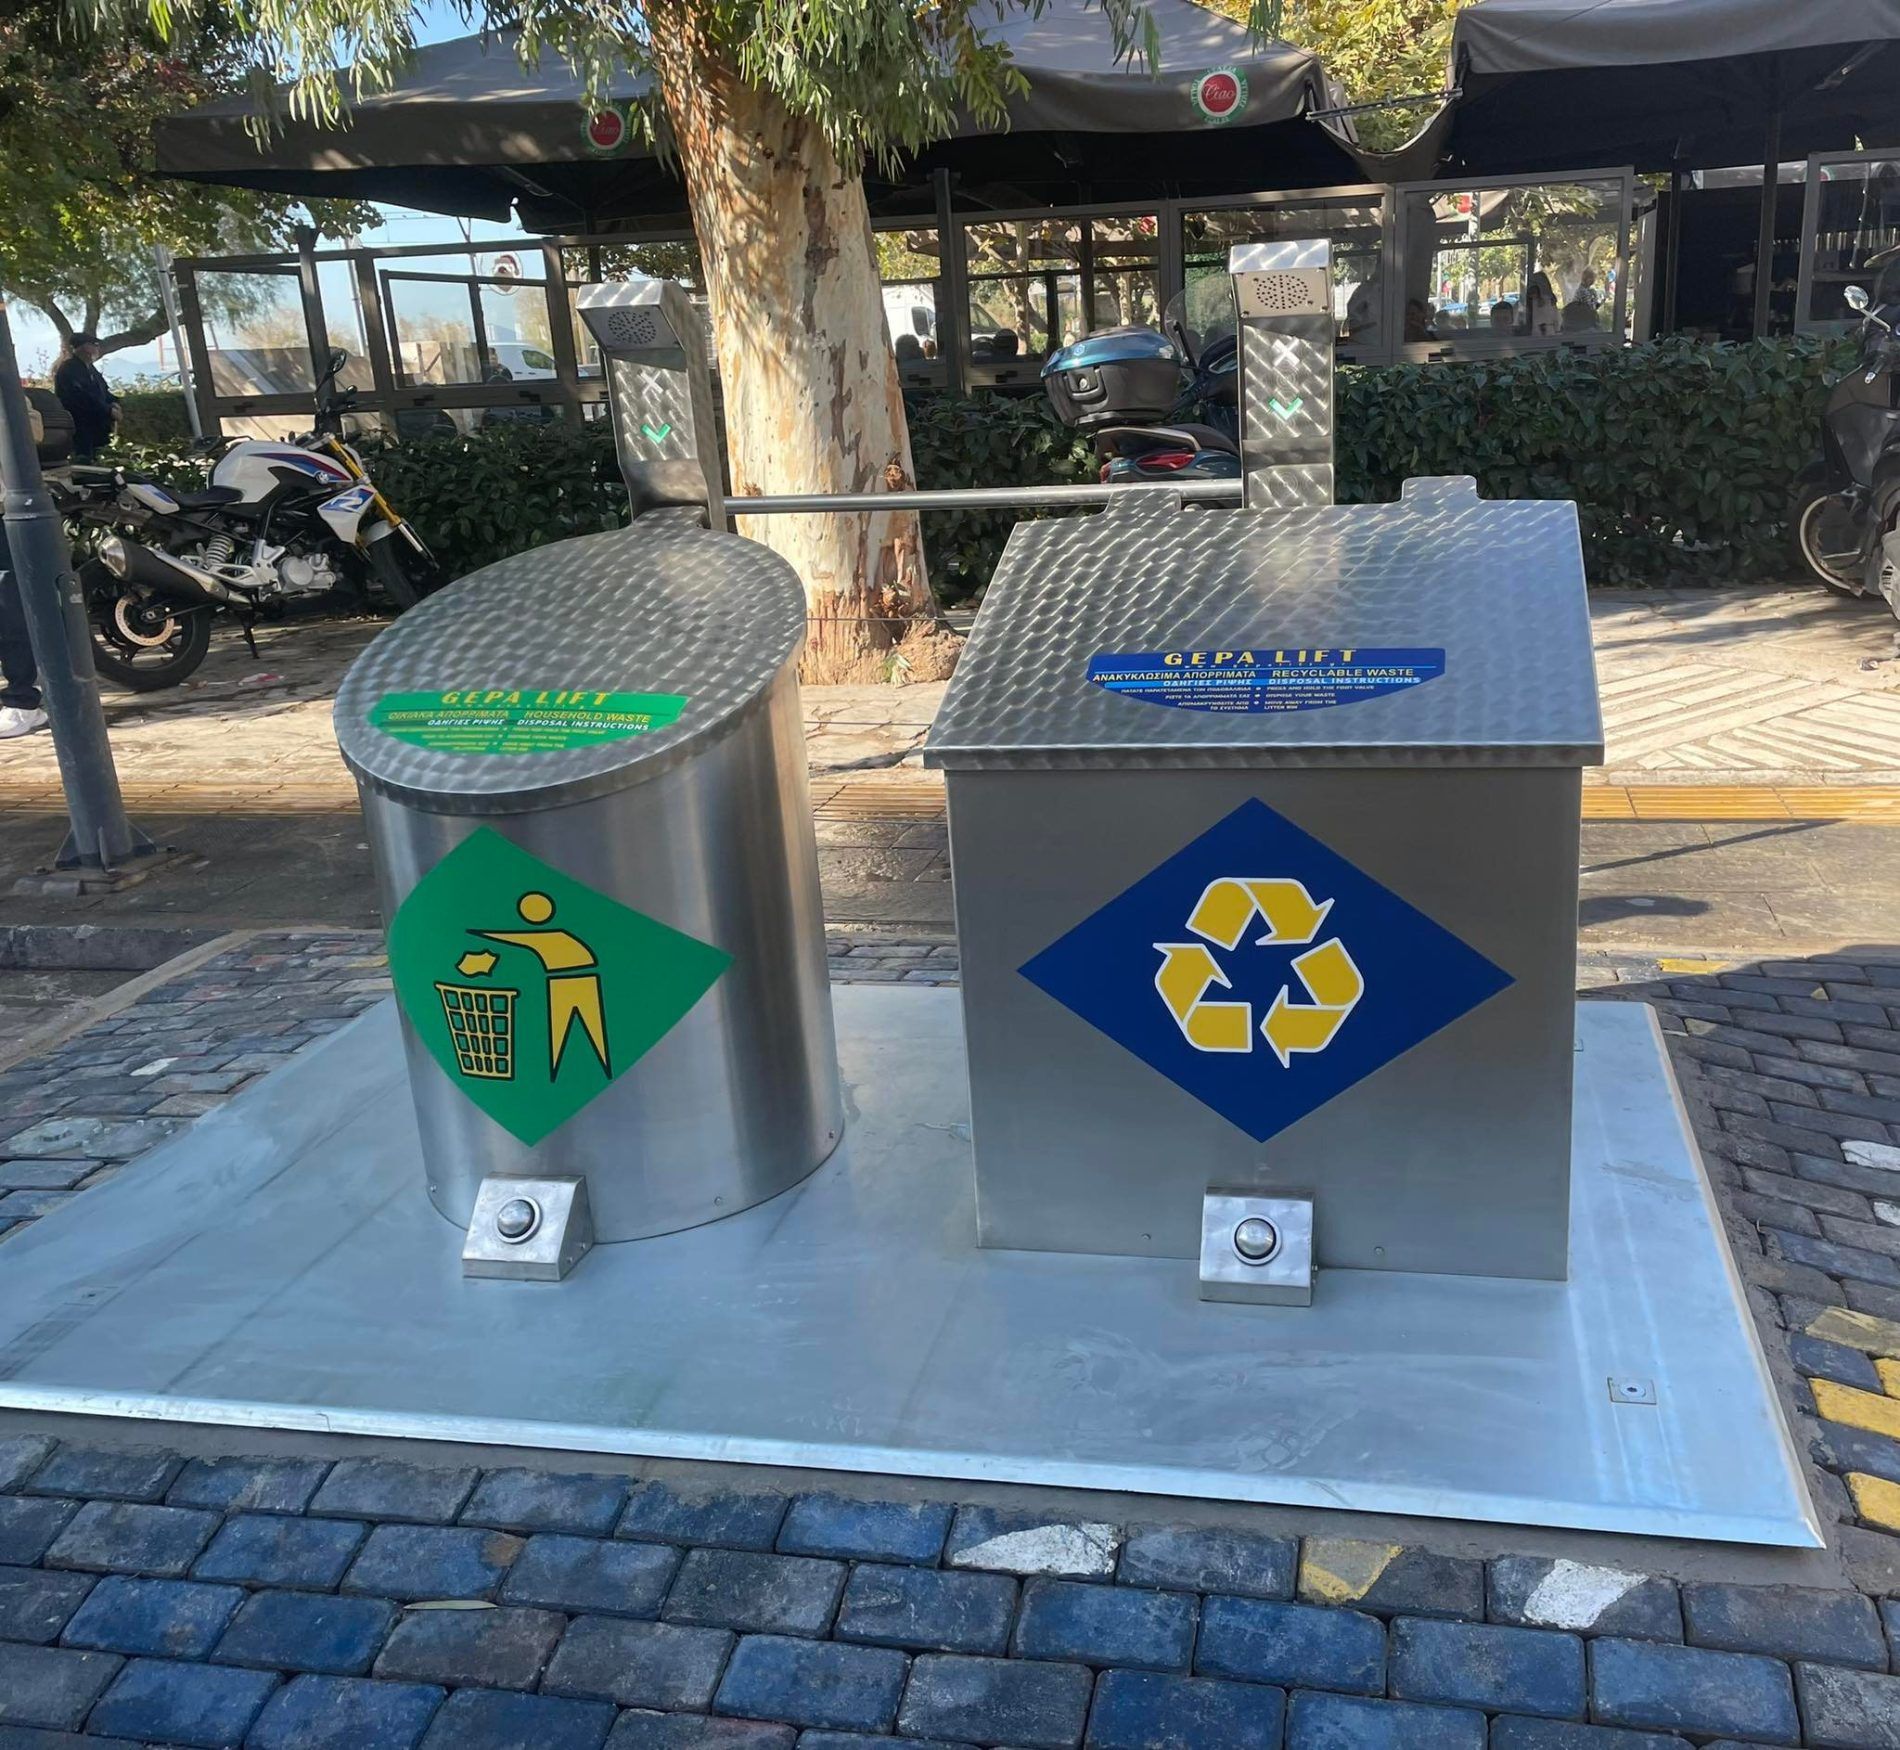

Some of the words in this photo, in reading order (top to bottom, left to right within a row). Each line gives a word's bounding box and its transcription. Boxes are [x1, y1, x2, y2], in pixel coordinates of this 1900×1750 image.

[1204, 83, 1235, 101] Ciao
[1163, 651, 1255, 665] GEPA
[1275, 649, 1357, 663] LIFT
[1092, 671, 1181, 682] ΑΝΑΚΥΚΛΩΣΙΜΑ
[1183, 670, 1256, 679] ΑΠΟΡΡΙΜΑΤΑ
[1272, 669, 1363, 678] RECYCLABLE
[1366, 668, 1414, 677] WASTE
[441, 690, 521, 704] GEPA
[535, 691, 611, 705] LIFT
[524, 710, 603, 721] HOUSEHOLD
[606, 713, 652, 723] WASTE
[517, 719, 568, 727] DISPOSAL
[571, 721, 649, 731] INSTRUCTIONS
